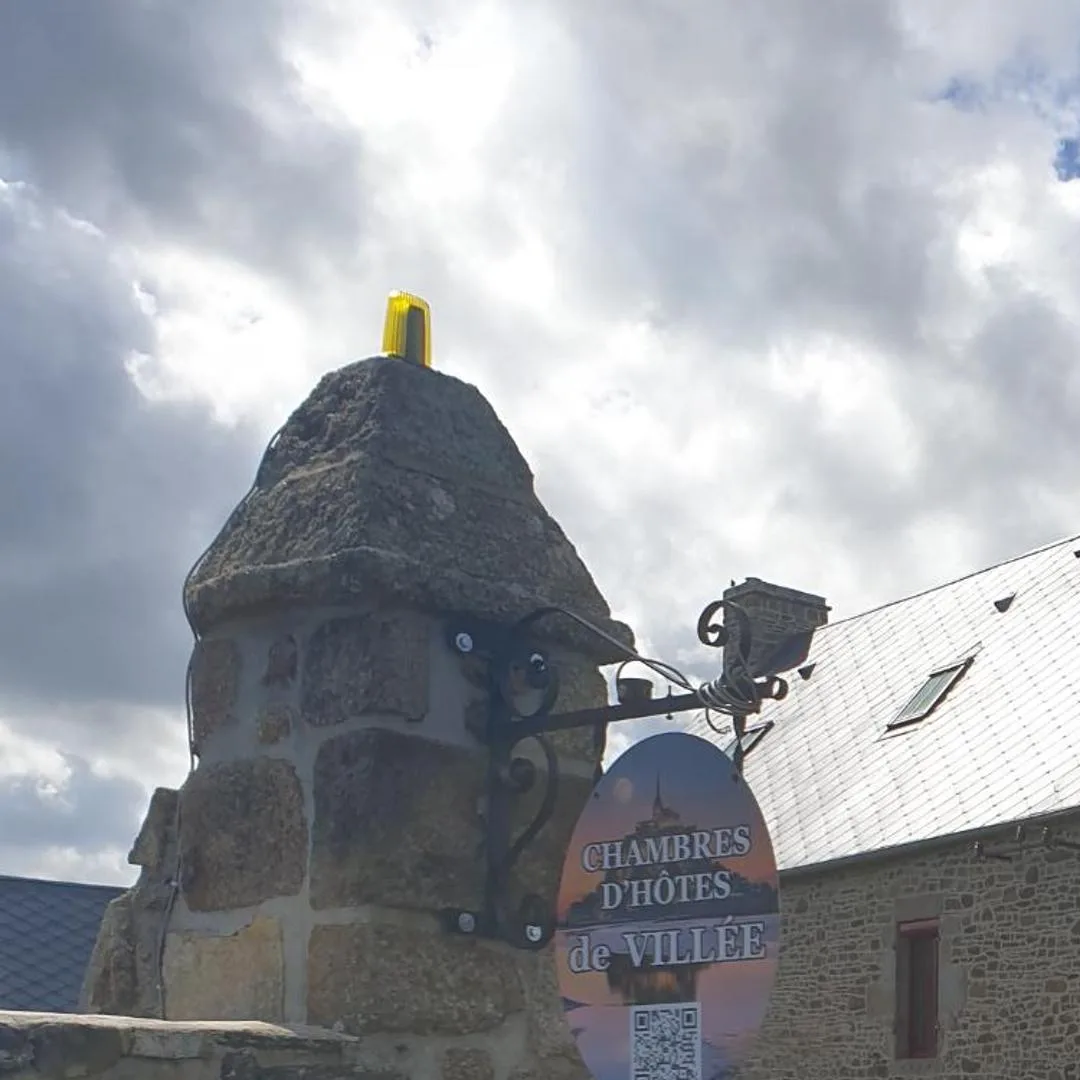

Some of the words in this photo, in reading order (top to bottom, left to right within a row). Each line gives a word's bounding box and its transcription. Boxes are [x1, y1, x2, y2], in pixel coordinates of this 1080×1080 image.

[582, 826, 751, 872] CHAMBRES
[601, 870, 731, 910] D'HÔTES
[569, 935, 612, 973] de
[622, 916, 766, 968] VILLÉE
